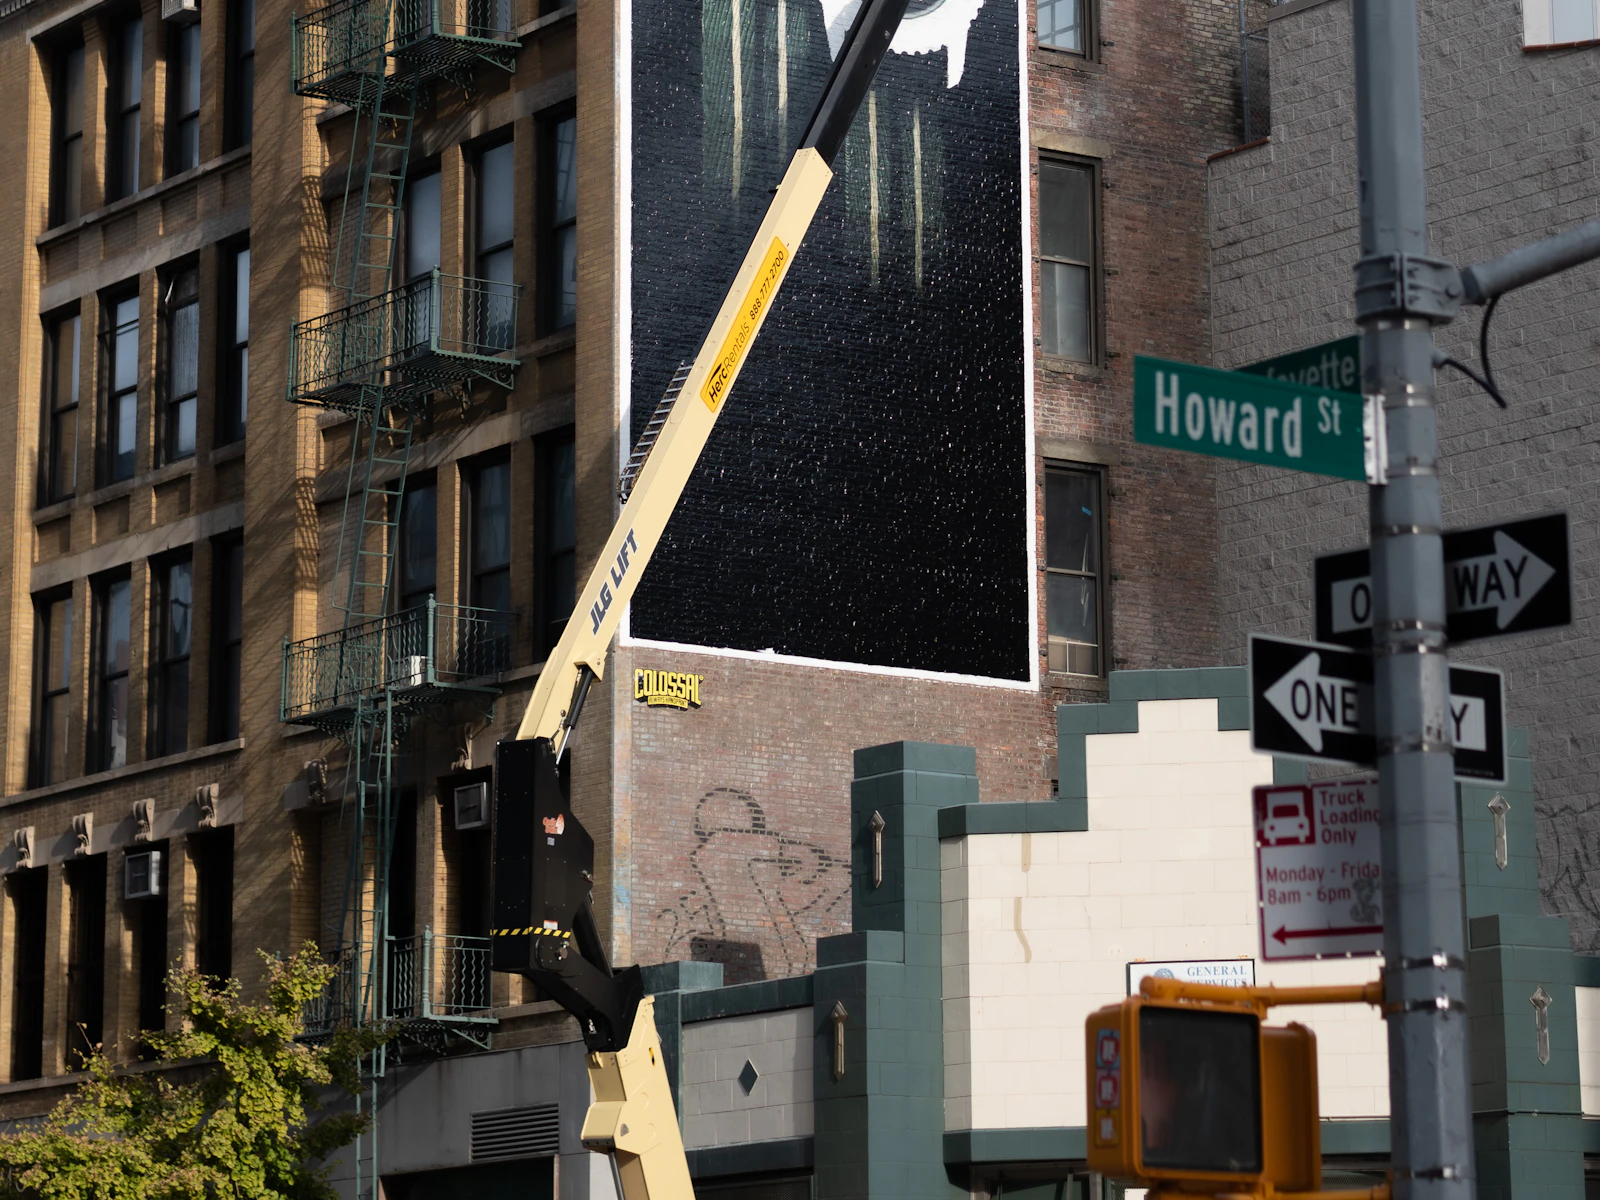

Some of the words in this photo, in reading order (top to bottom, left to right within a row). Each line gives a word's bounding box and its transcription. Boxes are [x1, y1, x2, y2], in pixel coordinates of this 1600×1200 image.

[749, 250, 784, 321] 888-777-2700
[1154, 369, 1303, 458] Howard
[1317, 395, 1342, 436] St
[590, 581, 613, 636] JLG
[610, 528, 638, 590] LIFT
[1453, 554, 1528, 608] WAY
[634, 668, 702, 706] COLOSSAL
[1291, 679, 1359, 728] ONE
[1319, 788, 1365, 807] Truck
[1321, 827, 1357, 846] Only
[1265, 866, 1326, 883] Monday
[1341, 861, 1380, 879] Frida
[1267, 888, 1301, 905] 8am
[1316, 886, 1351, 905] 6pm
[1187, 965, 1247, 977] GENERAL
